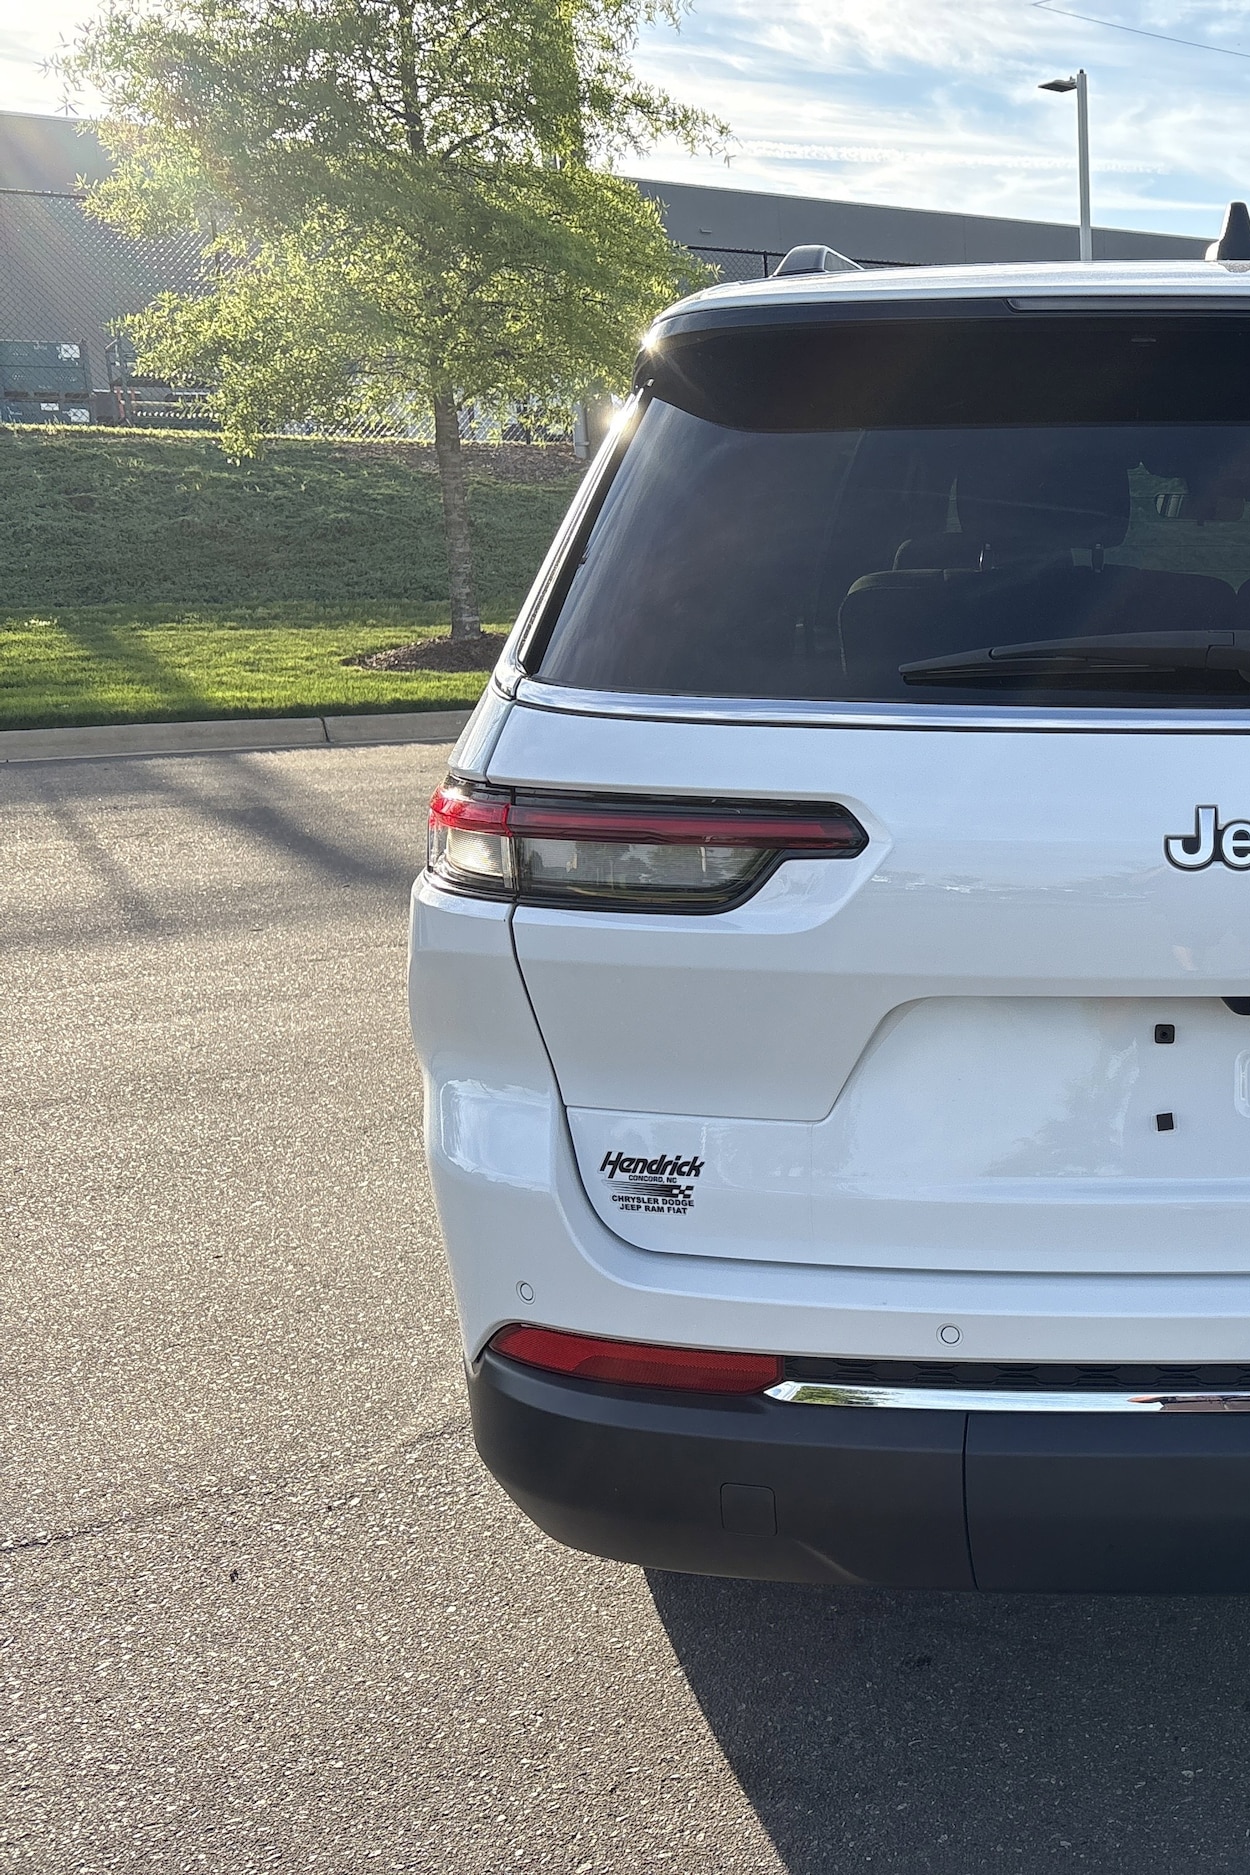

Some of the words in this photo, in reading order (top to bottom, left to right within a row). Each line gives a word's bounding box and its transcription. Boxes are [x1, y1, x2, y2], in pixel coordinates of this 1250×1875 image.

[599, 1151, 705, 1179] Hendrick
[611, 1194, 659, 1205] CHRYSLER
[661, 1198, 695, 1207] DODGE
[619, 1203, 642, 1211] JEEP
[644, 1205, 665, 1213] RAM
[667, 1207, 688, 1215] FIAT
